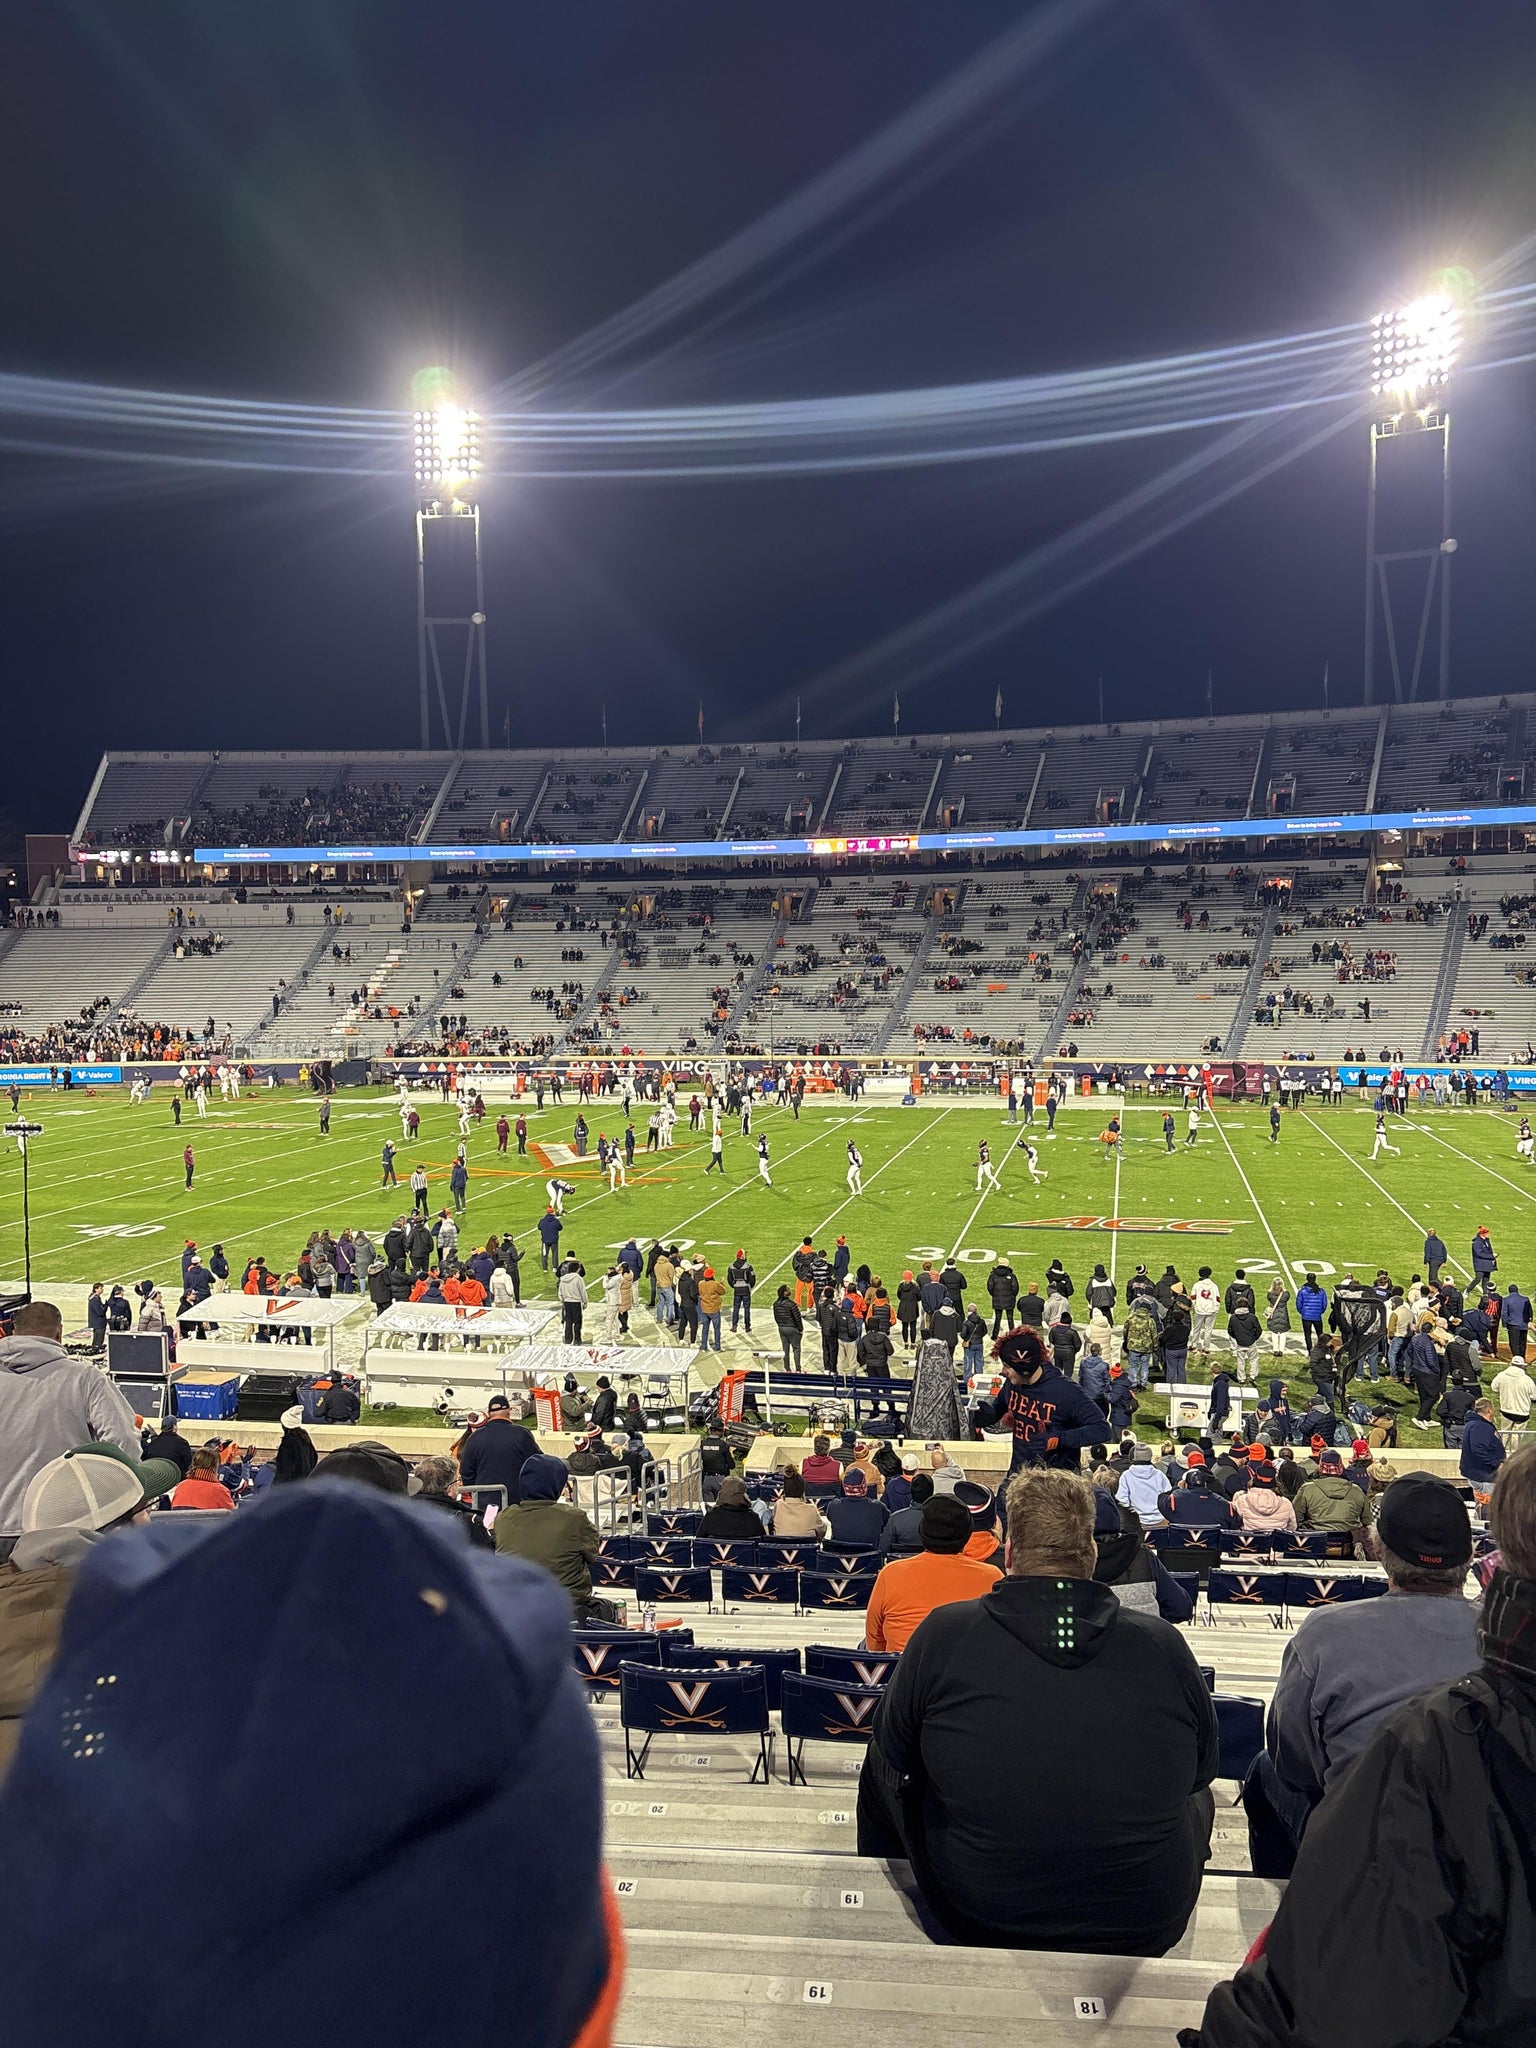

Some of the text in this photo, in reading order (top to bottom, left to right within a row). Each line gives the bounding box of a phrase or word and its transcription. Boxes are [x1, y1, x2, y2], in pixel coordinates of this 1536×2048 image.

[1000, 1215, 1255, 1233] ACC
[76, 1224, 167, 1238] 40
[905, 1246, 998, 1263] 30
[1235, 1258, 1337, 1276] 20
[697, 1757, 708, 1765] 20
[652, 1805, 664, 1813] 20
[834, 1814, 846, 1822] 19
[618, 1882, 633, 1892] 20
[845, 1894, 859, 1904] 19
[809, 1986, 827, 1998] 19
[1080, 2001, 1099, 2014] 18
